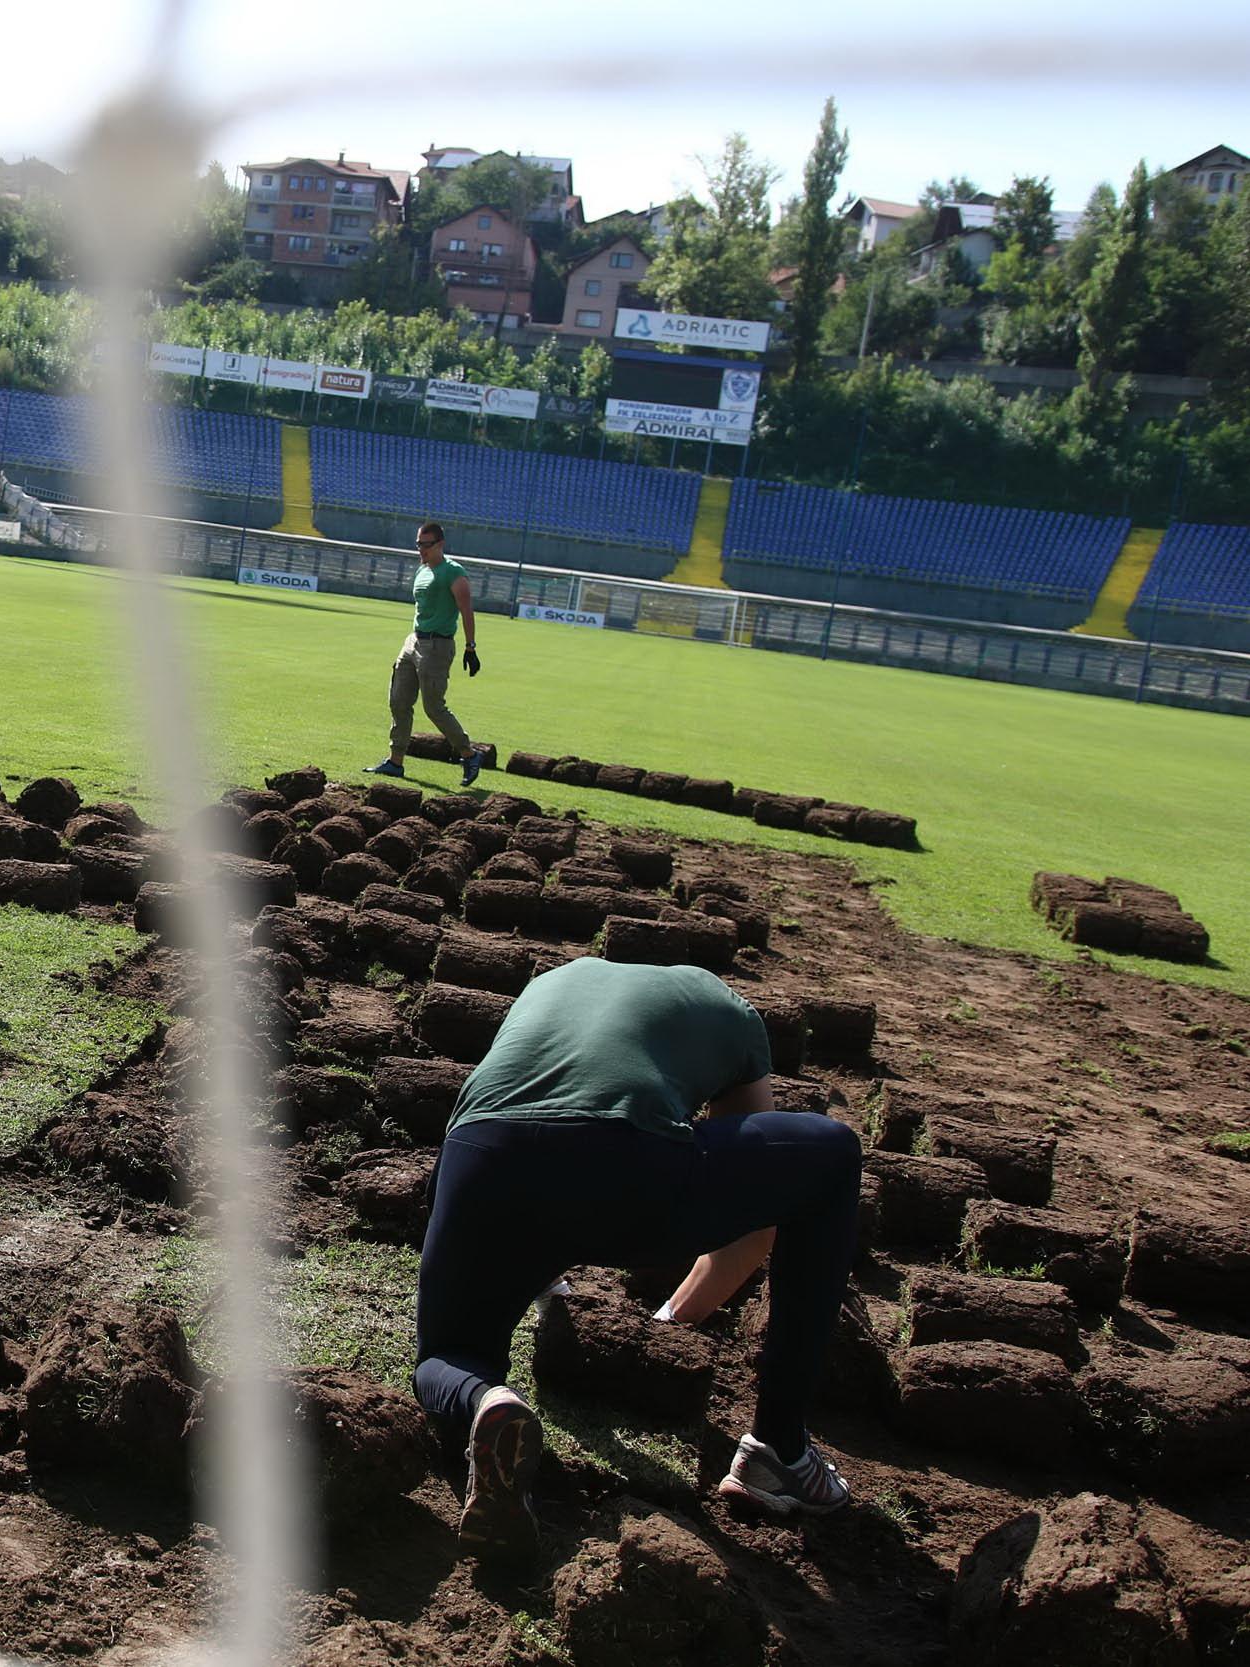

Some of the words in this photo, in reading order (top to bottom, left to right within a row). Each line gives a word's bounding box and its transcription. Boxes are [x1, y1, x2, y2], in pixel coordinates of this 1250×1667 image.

[662, 319, 750, 338] ADRIATIC
[326, 374, 361, 387] natura
[429, 380, 481, 396] ADMIRAL
[702, 411, 711, 421] A
[730, 413, 739, 424] Z
[633, 420, 721, 441] ADMIRAL
[261, 572, 311, 588] ŠKODA
